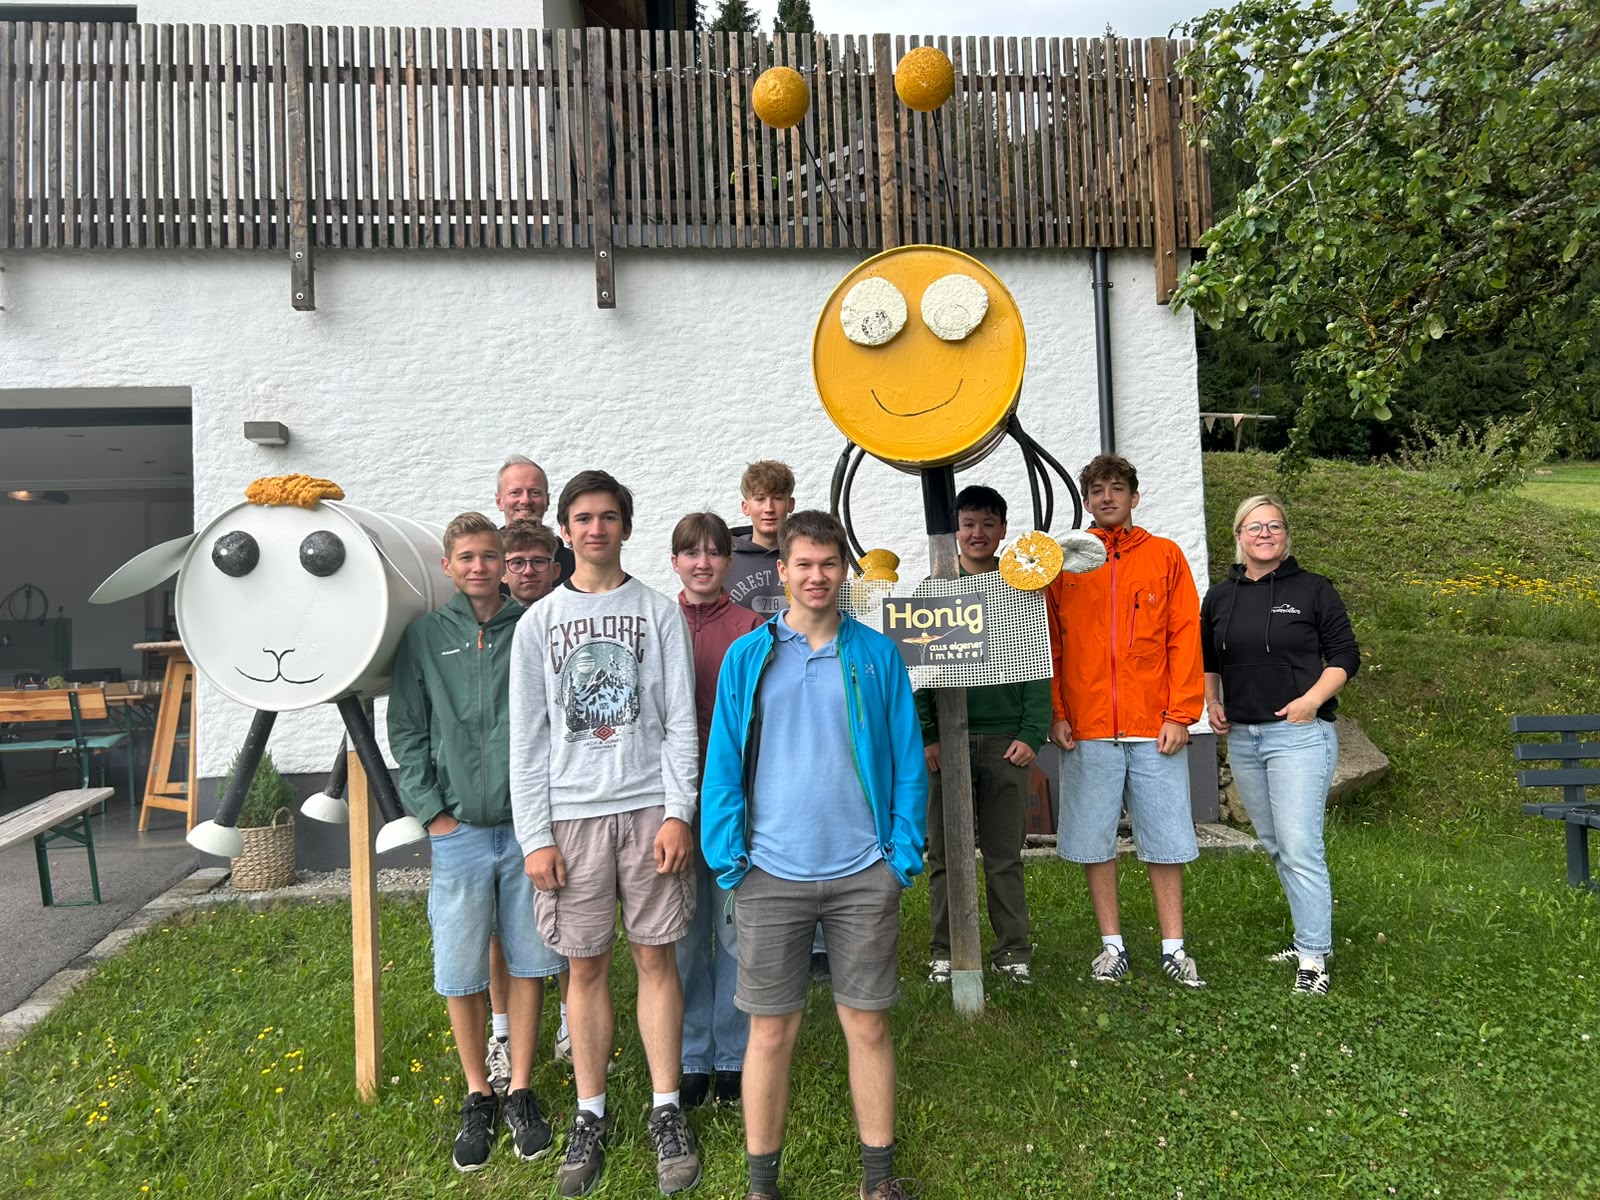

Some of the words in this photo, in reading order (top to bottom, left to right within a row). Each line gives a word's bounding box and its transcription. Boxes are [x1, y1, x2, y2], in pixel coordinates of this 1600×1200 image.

[762, 598, 780, 611] 718
[885, 598, 984, 635] Honig
[549, 615, 647, 675] EXPLORE
[929, 643, 948, 651] aus
[949, 641, 984, 652] eigener
